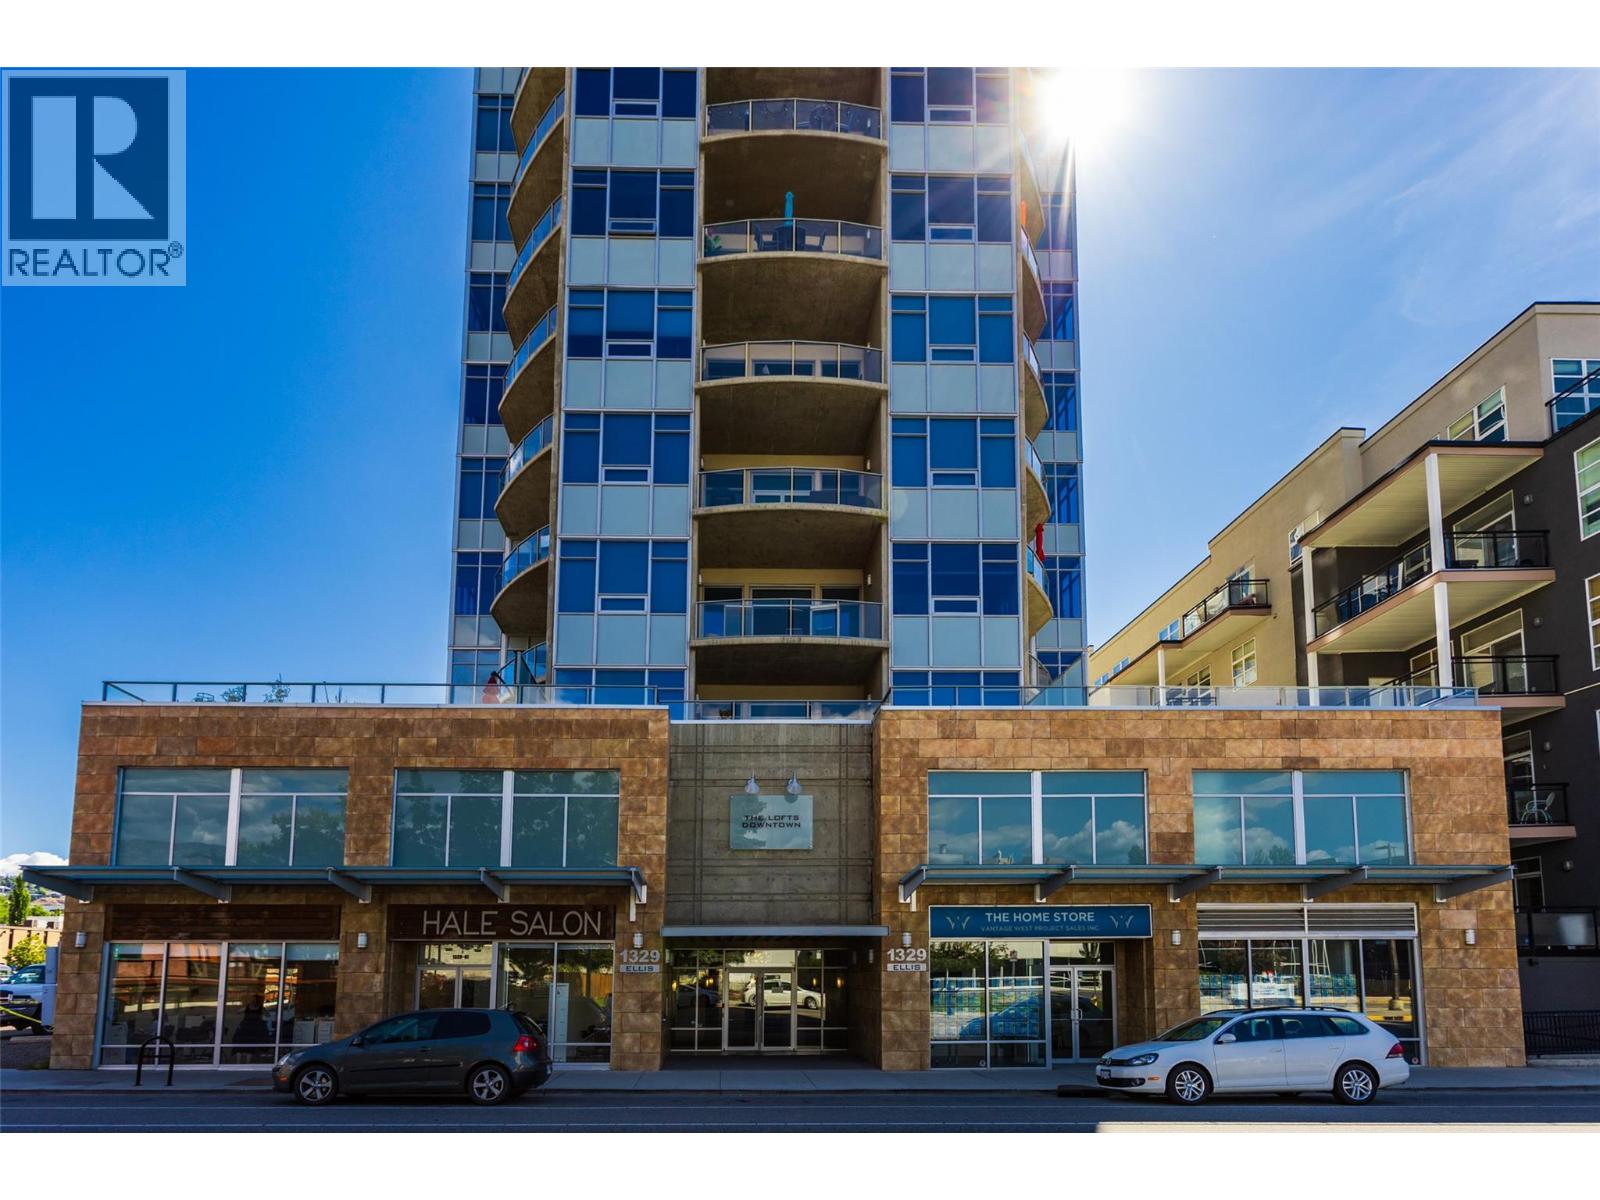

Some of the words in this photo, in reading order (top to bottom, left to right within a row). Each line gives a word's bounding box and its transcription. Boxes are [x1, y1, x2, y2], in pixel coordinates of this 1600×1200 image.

[422, 910, 498, 936] HALE
[509, 911, 601, 936] SALON
[985, 912, 1010, 922] THE
[1013, 912, 1050, 922] HOME
[1053, 912, 1095, 922] STORE
[620, 949, 660, 963] 1329
[887, 948, 927, 961] 1329
